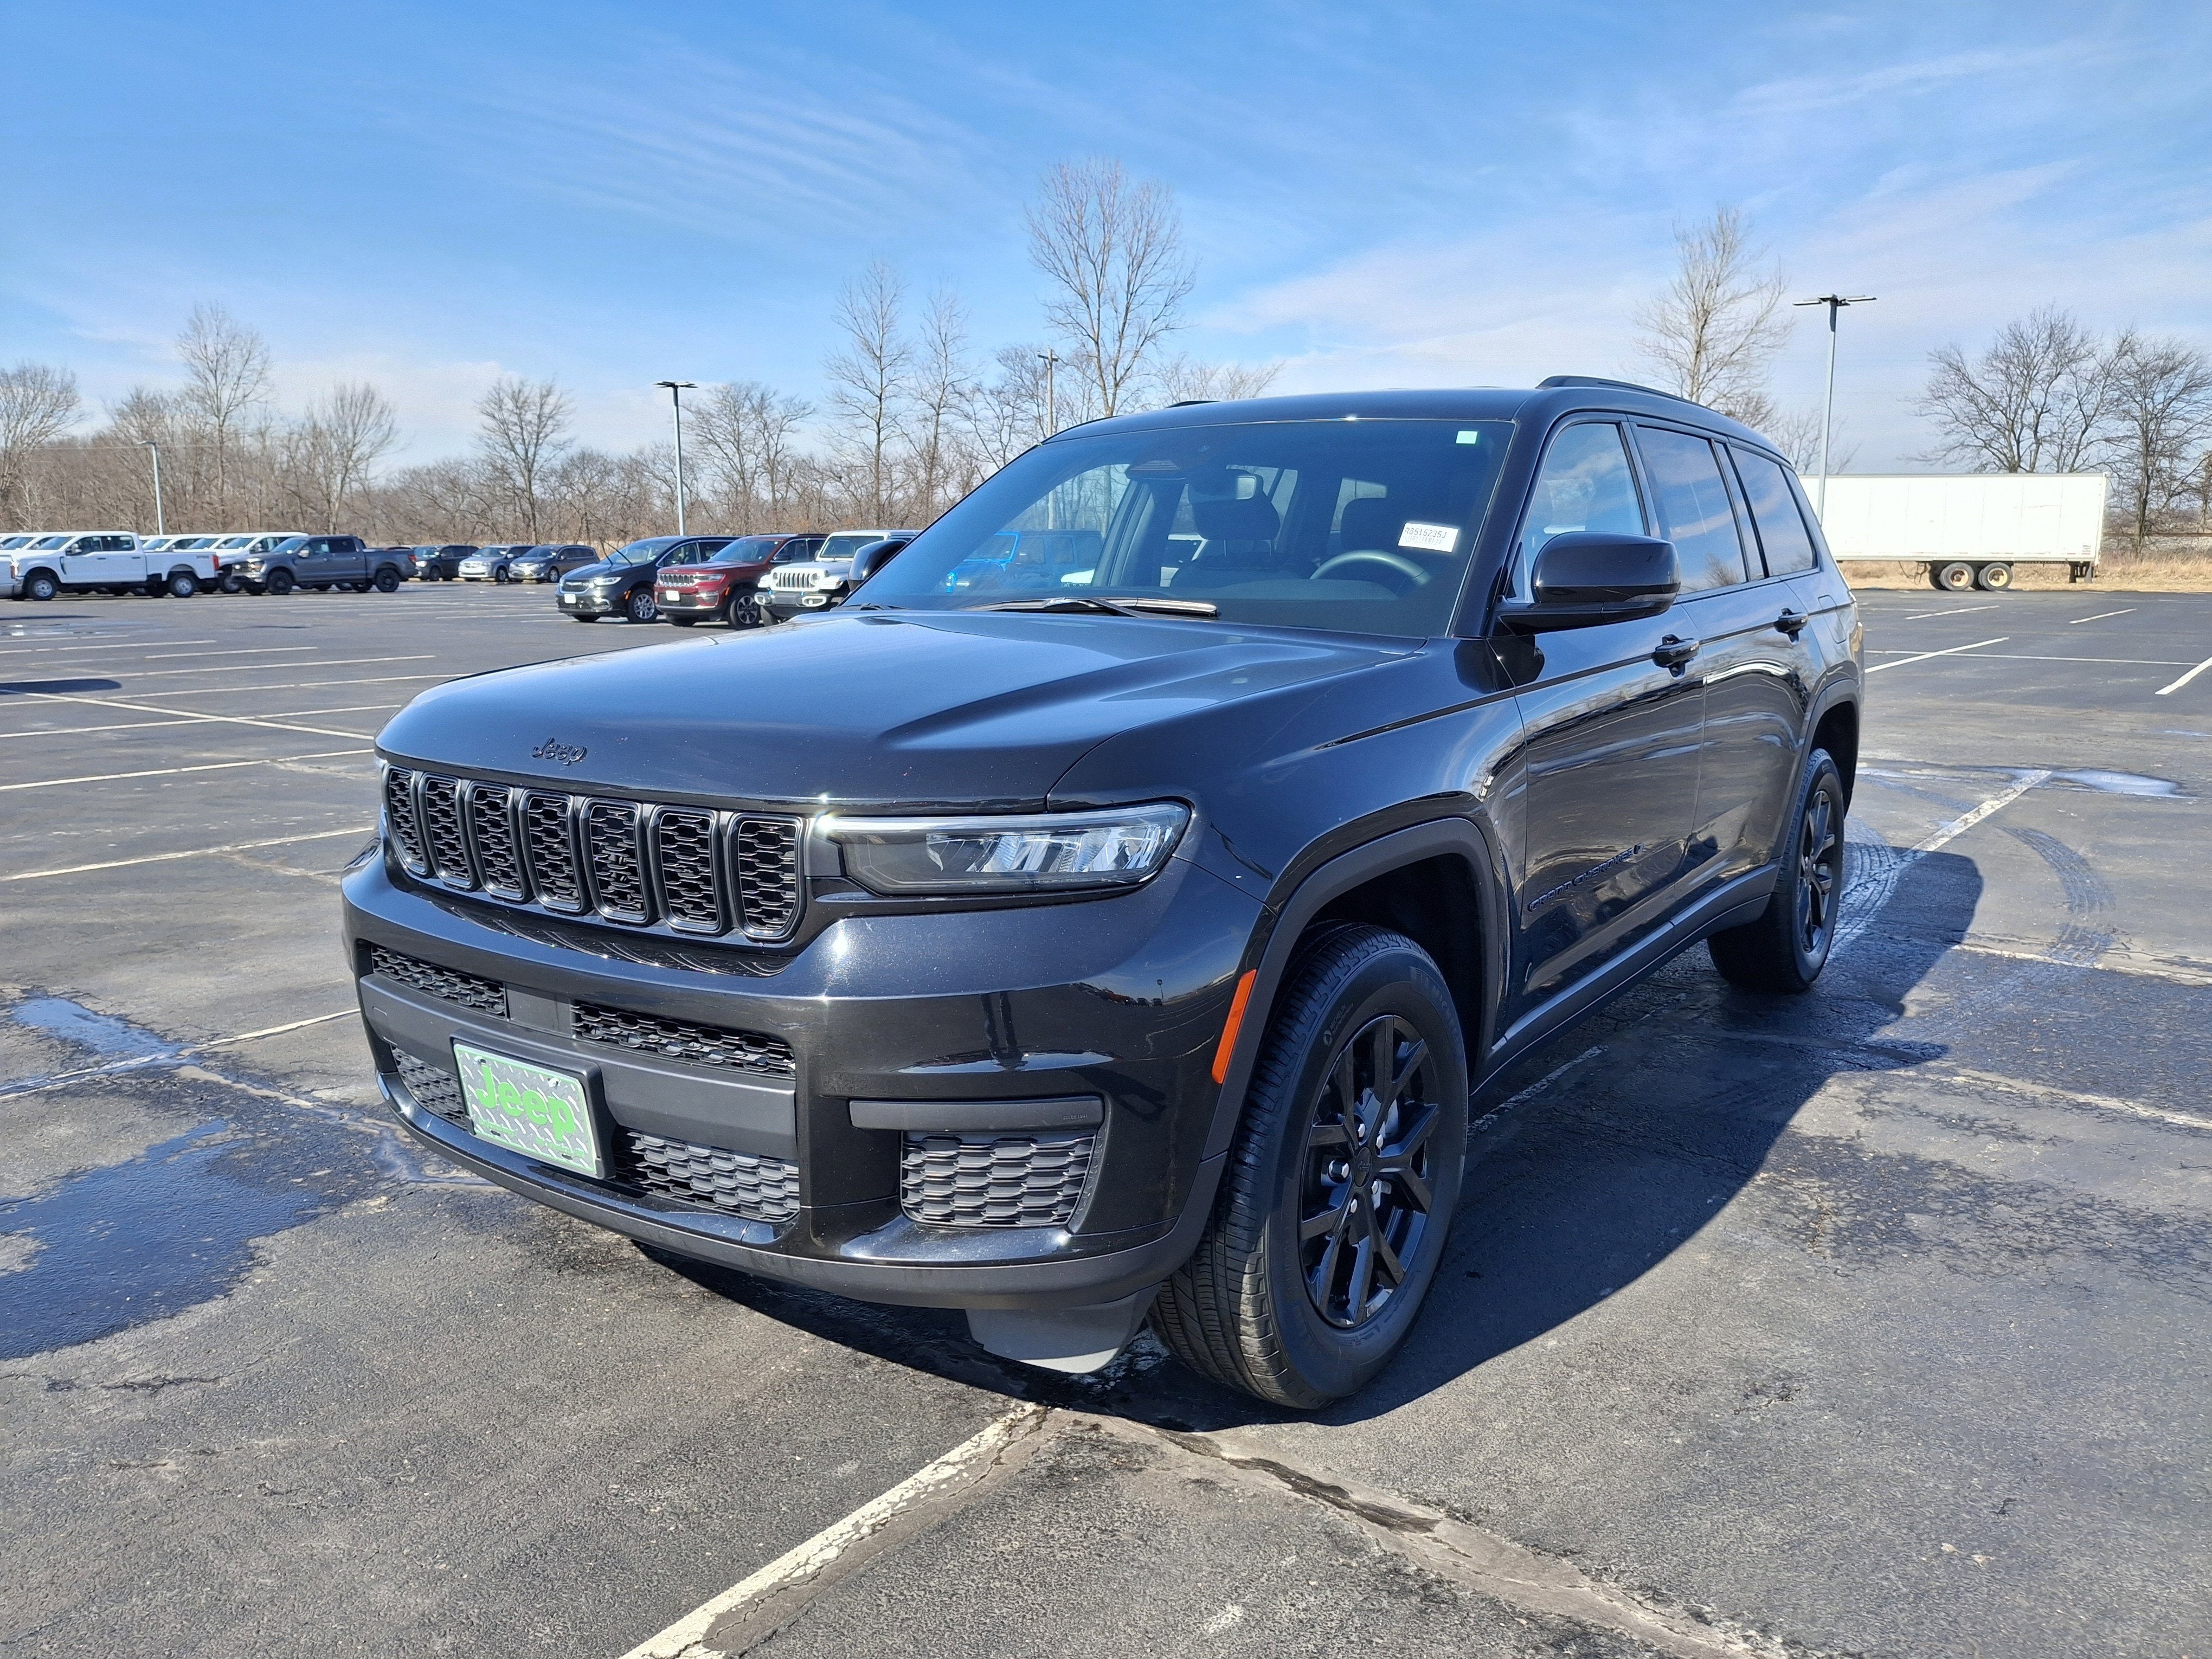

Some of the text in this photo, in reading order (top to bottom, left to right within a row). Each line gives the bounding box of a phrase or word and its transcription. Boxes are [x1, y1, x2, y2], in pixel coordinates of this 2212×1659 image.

[1404, 527, 1447, 539] R8515235J
[531, 737, 587, 766] Jeep
[475, 1064, 576, 1142] Jeep
